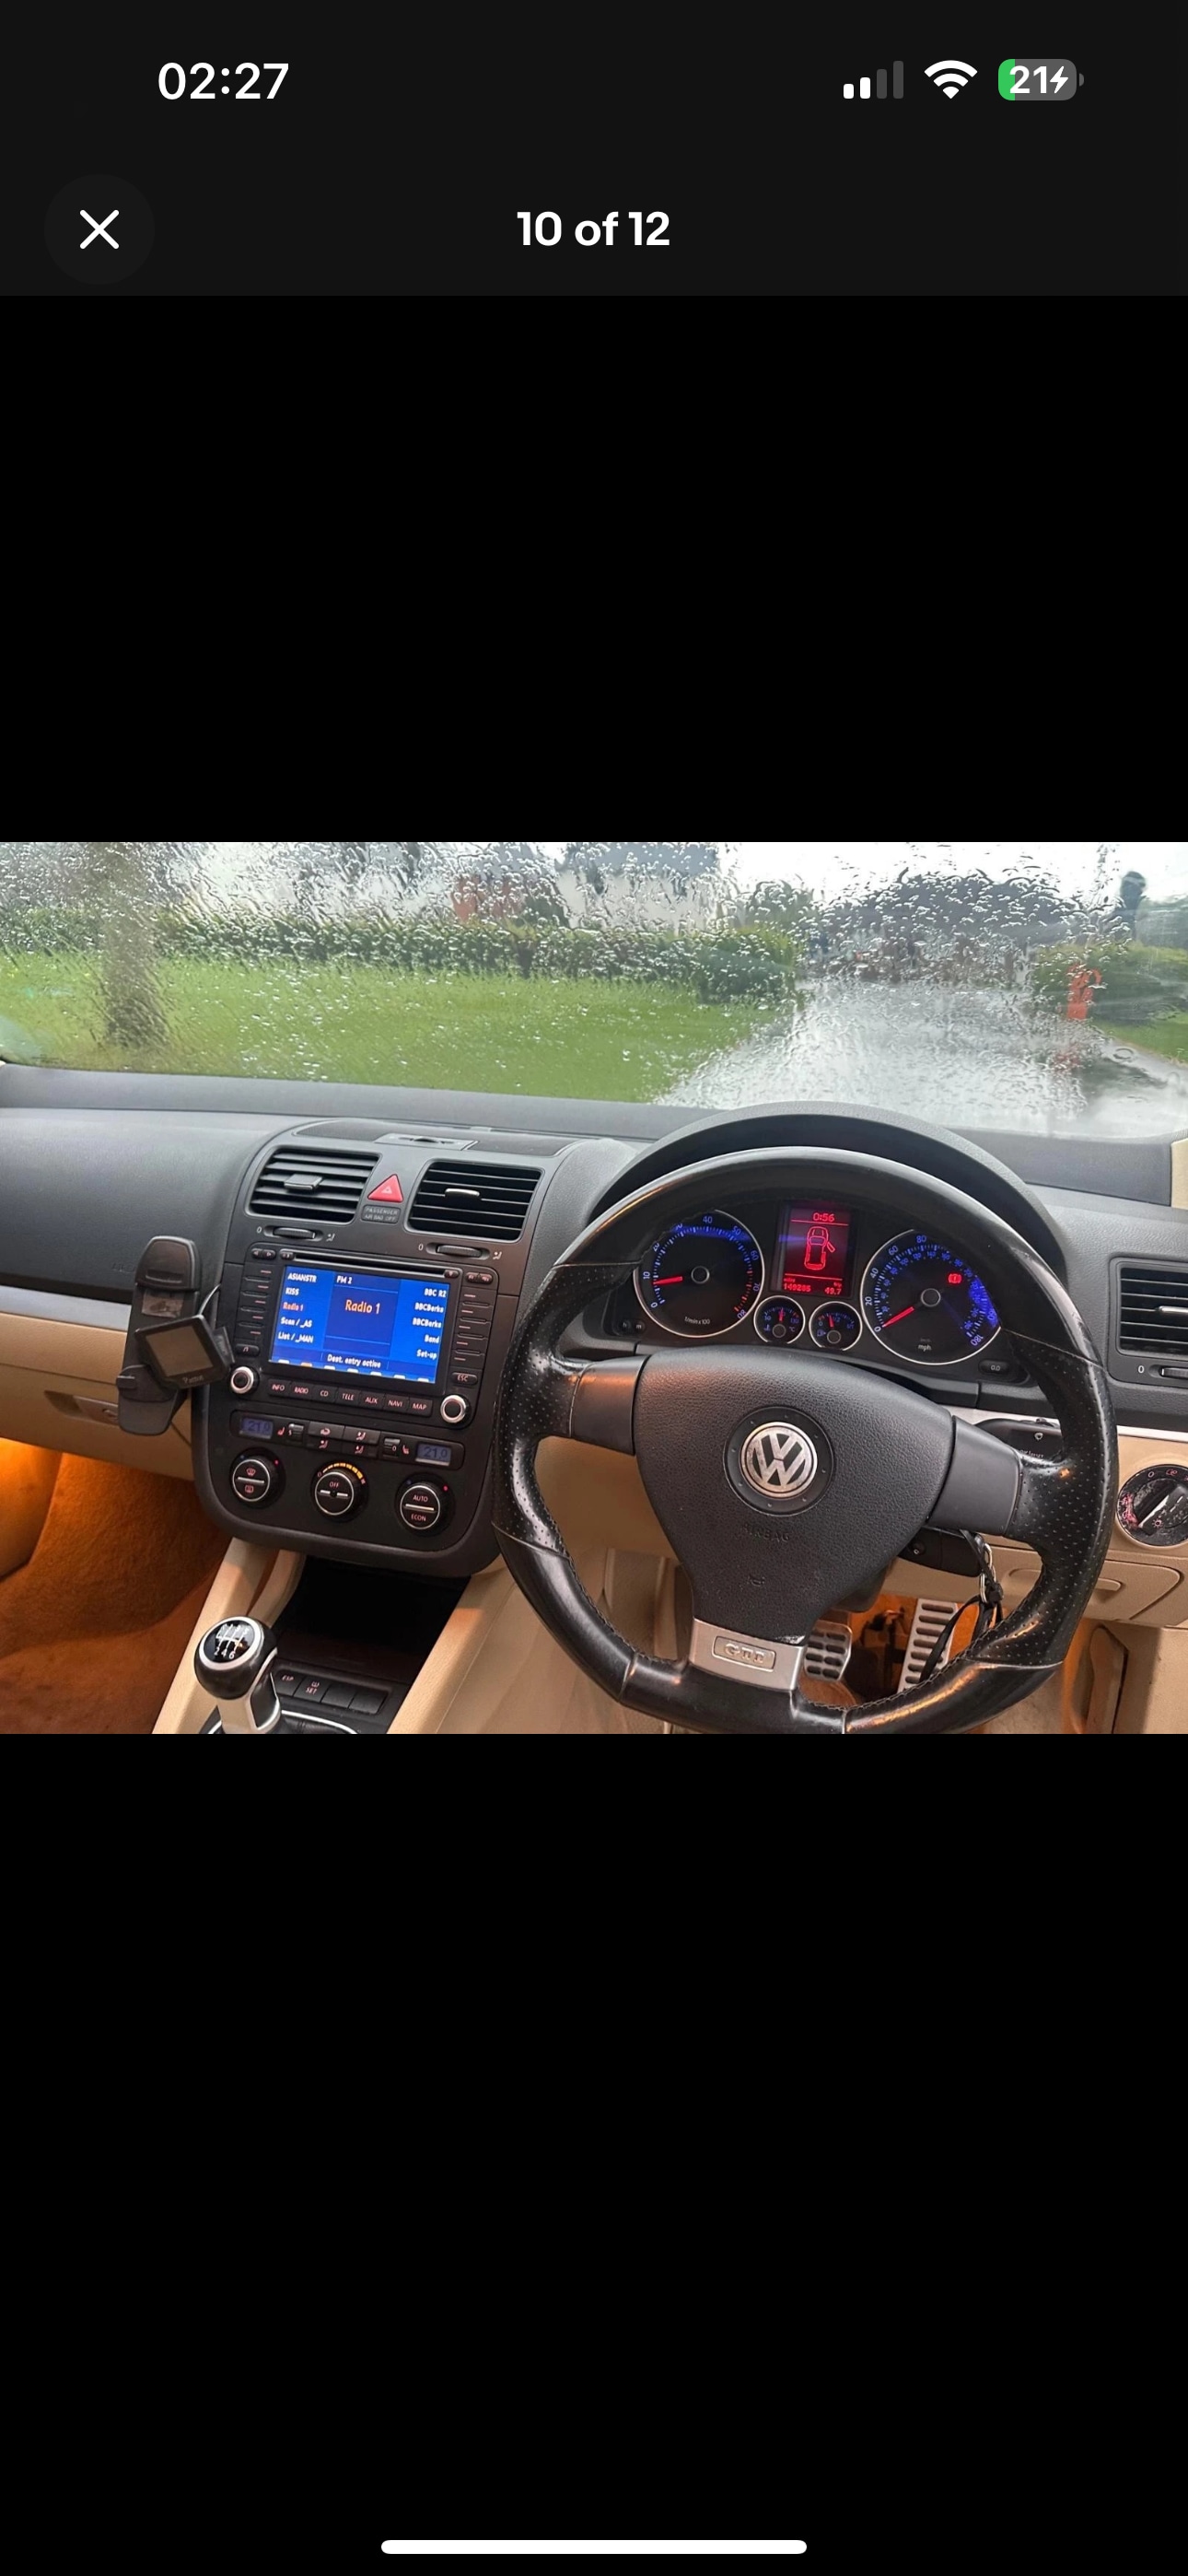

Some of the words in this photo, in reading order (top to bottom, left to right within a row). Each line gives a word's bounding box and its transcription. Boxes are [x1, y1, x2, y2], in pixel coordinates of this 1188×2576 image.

[813, 1212, 835, 1222] 0:56
[732, 1225, 741, 1235] 50
[751, 1250, 759, 1260] 60
[889, 1245, 899, 1255] 60
[287, 1272, 318, 1283] ASIANSTR
[643, 1271, 650, 1280] 10
[870, 1268, 879, 1279] 40
[336, 1275, 347, 1284] FM
[347, 1276, 353, 1284] 2
[285, 1287, 300, 1296] KISS
[424, 1288, 437, 1297] BBC
[437, 1290, 447, 1298] R2
[824, 1287, 842, 1295] 49.7
[865, 1296, 873, 1306] 20
[283, 1302, 299, 1311] Radio
[344, 1299, 373, 1314] Radio
[376, 1303, 380, 1315] 1
[281, 1317, 296, 1326] Scan
[278, 1331, 290, 1341] List
[424, 1334, 440, 1344] Band
[970, 1334, 984, 1346] 180
[917, 1344, 932, 1352] mph
[416, 1349, 437, 1361] Set-up
[327, 1353, 344, 1364] Dest.
[344, 1357, 361, 1367] entry
[362, 1359, 381, 1368] active
[1137, 1365, 1145, 1374] 0
[320, 1389, 329, 1398] CD
[365, 1397, 379, 1405] AUX
[742, 1423, 817, 1497] VW
[413, 1494, 428, 1503] AUTO
[411, 1513, 426, 1522] ECON
